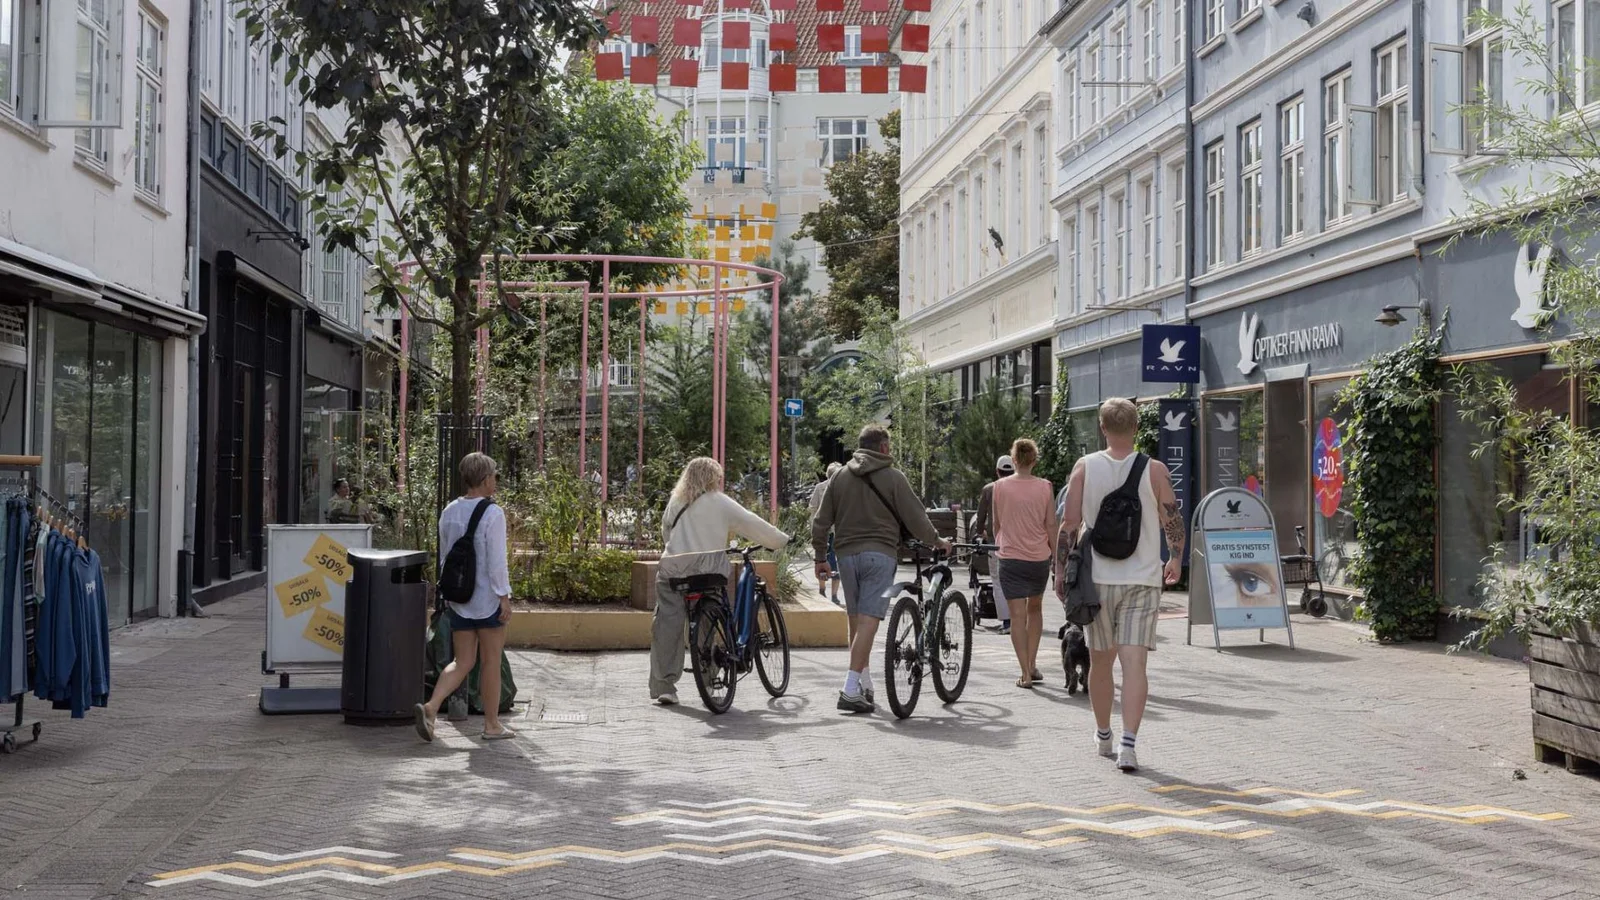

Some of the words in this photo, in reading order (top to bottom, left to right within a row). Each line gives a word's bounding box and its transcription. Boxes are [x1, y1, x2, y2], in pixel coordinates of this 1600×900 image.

[1254, 332, 1289, 360] OPTIKER
[1289, 327, 1312, 354] FINN
[1312, 321, 1339, 350] RAVN
[1146, 364, 1197, 372] RAVN
[1167, 446, 1184, 492] FINN
[1236, 543, 1270, 551] SYNSTEST
[315, 554, 346, 576] -50%
[289, 586, 321, 606] -50%
[314, 625, 344, 646] -50%
